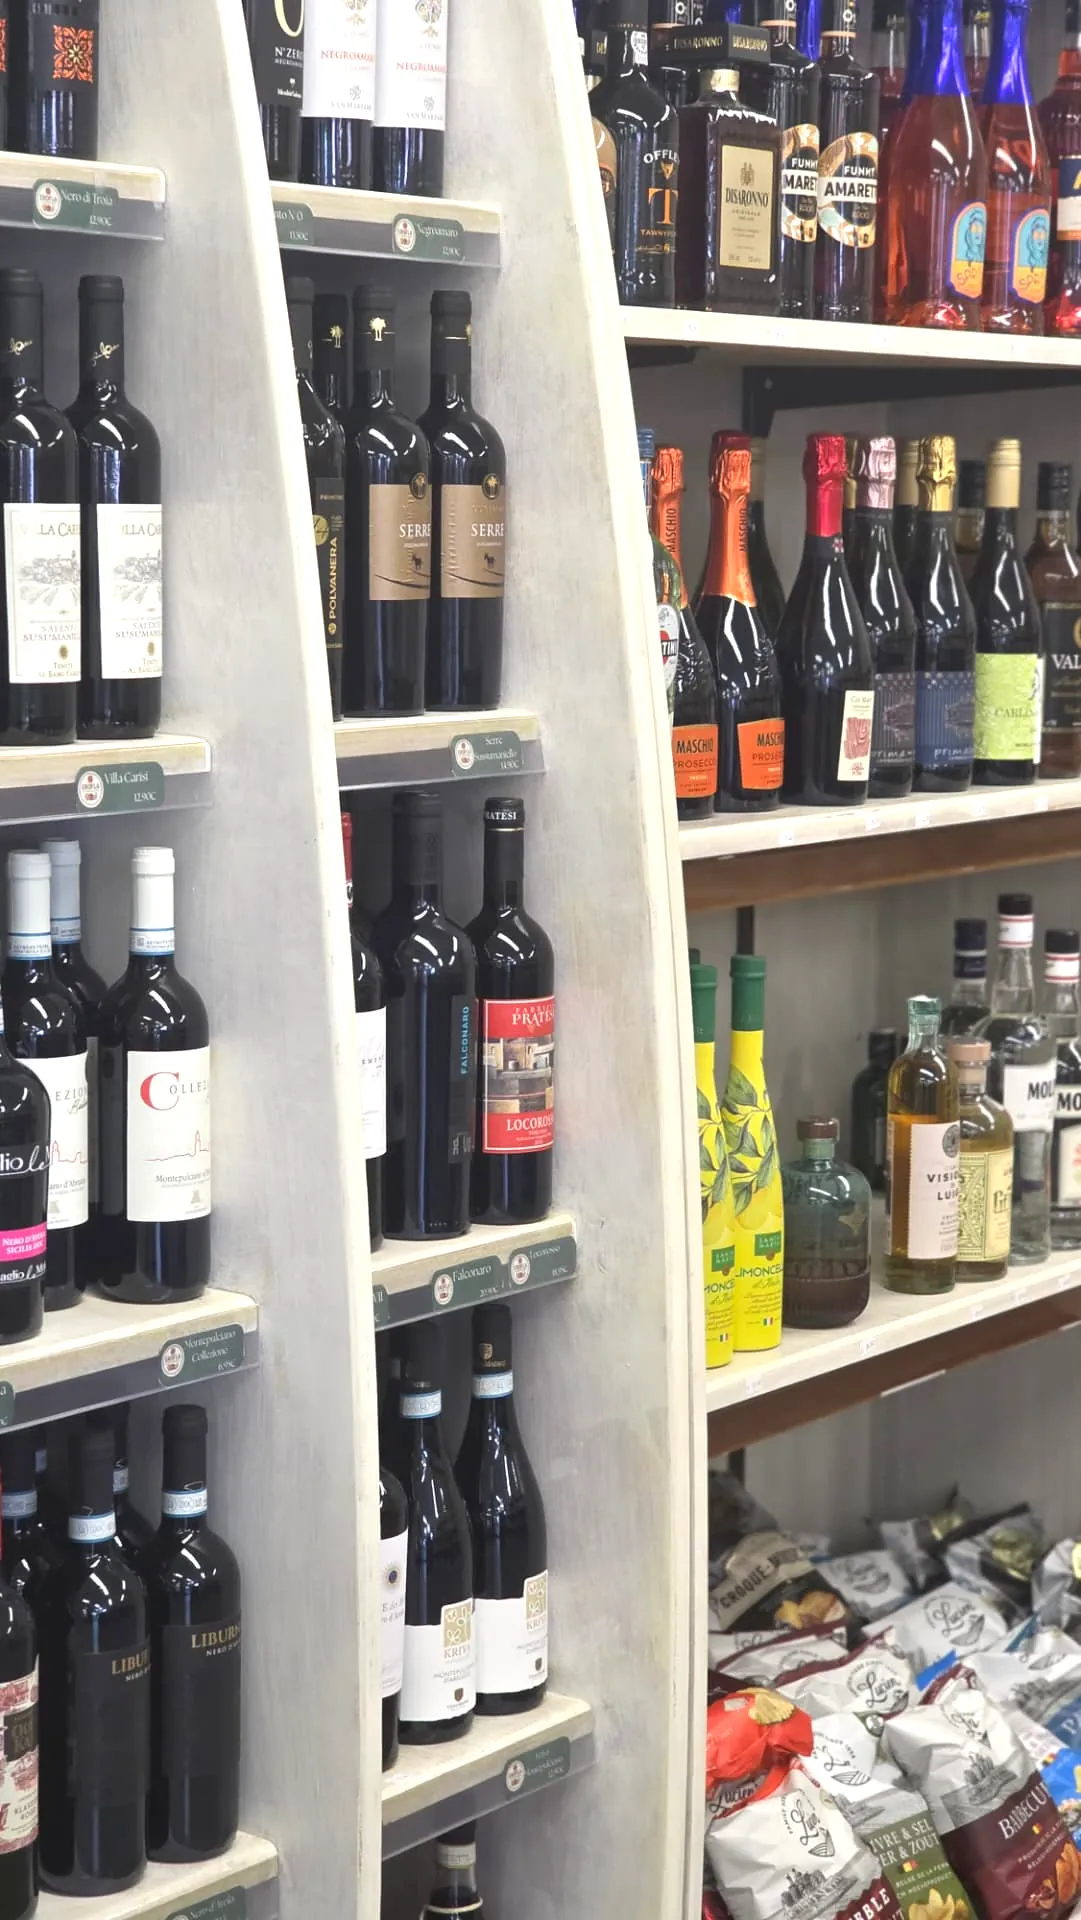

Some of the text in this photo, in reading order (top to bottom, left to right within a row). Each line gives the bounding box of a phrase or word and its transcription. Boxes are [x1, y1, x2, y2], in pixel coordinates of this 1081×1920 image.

[726, 188, 769, 208] DISARONNO
[666, 508, 677, 553] MASCHIO
[328, 536, 338, 620] POLVANERA
[104, 772, 123, 784] Villa
[460, 1006, 470, 1074] FALCONARO
[452, 1264, 492, 1283] Falconaro
[901, 1826, 912, 1840] &
[911, 1818, 933, 1836] SEL
[898, 1846, 909, 1860] &
[908, 1832, 940, 1855] ZOUT
